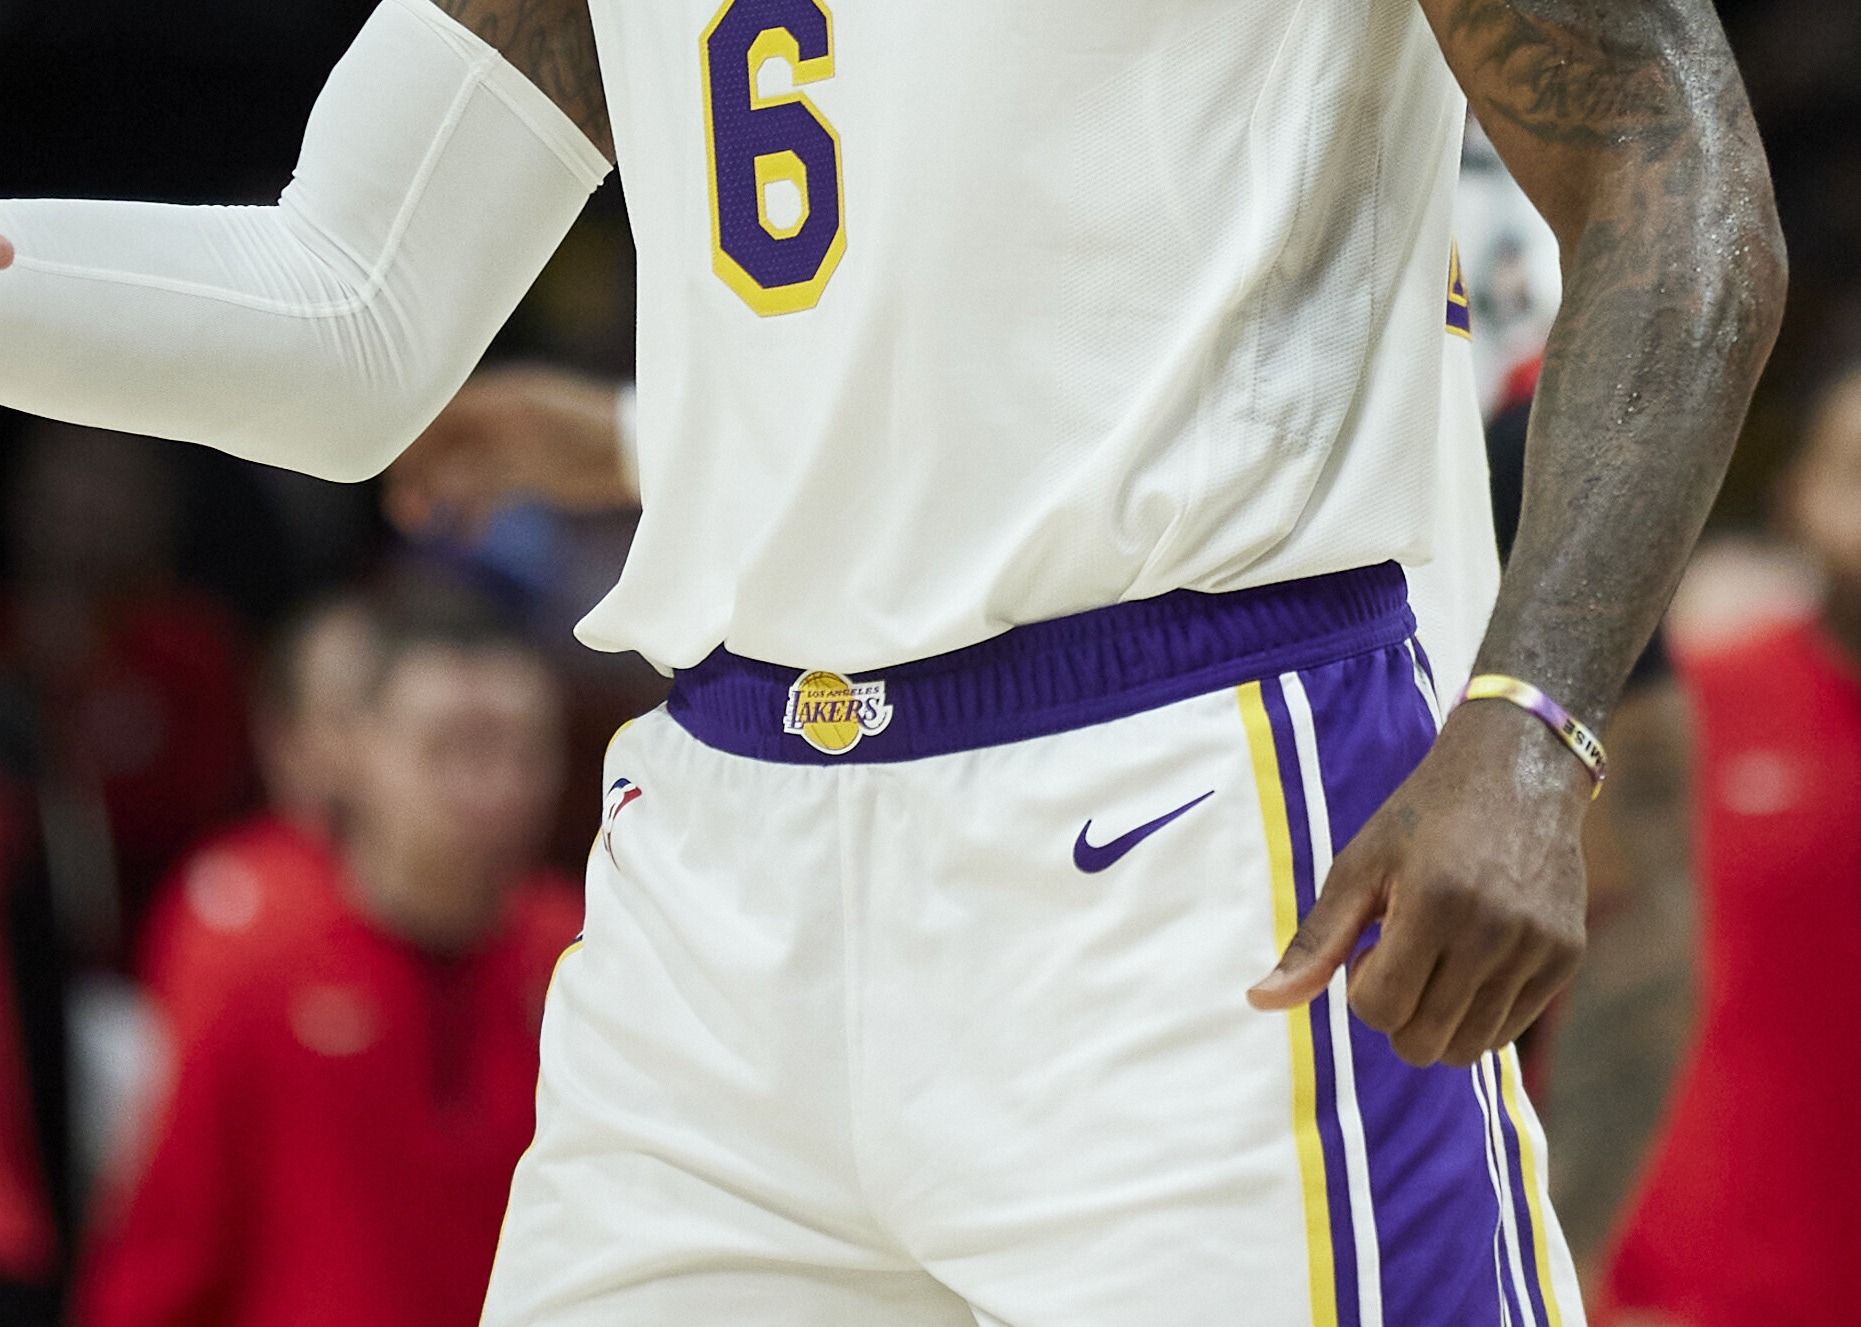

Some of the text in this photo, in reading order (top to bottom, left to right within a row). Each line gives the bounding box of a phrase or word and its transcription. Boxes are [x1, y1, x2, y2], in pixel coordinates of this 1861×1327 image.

[808, 685, 880, 698] LOS ANGELES
[787, 690, 888, 731] LAKERS
